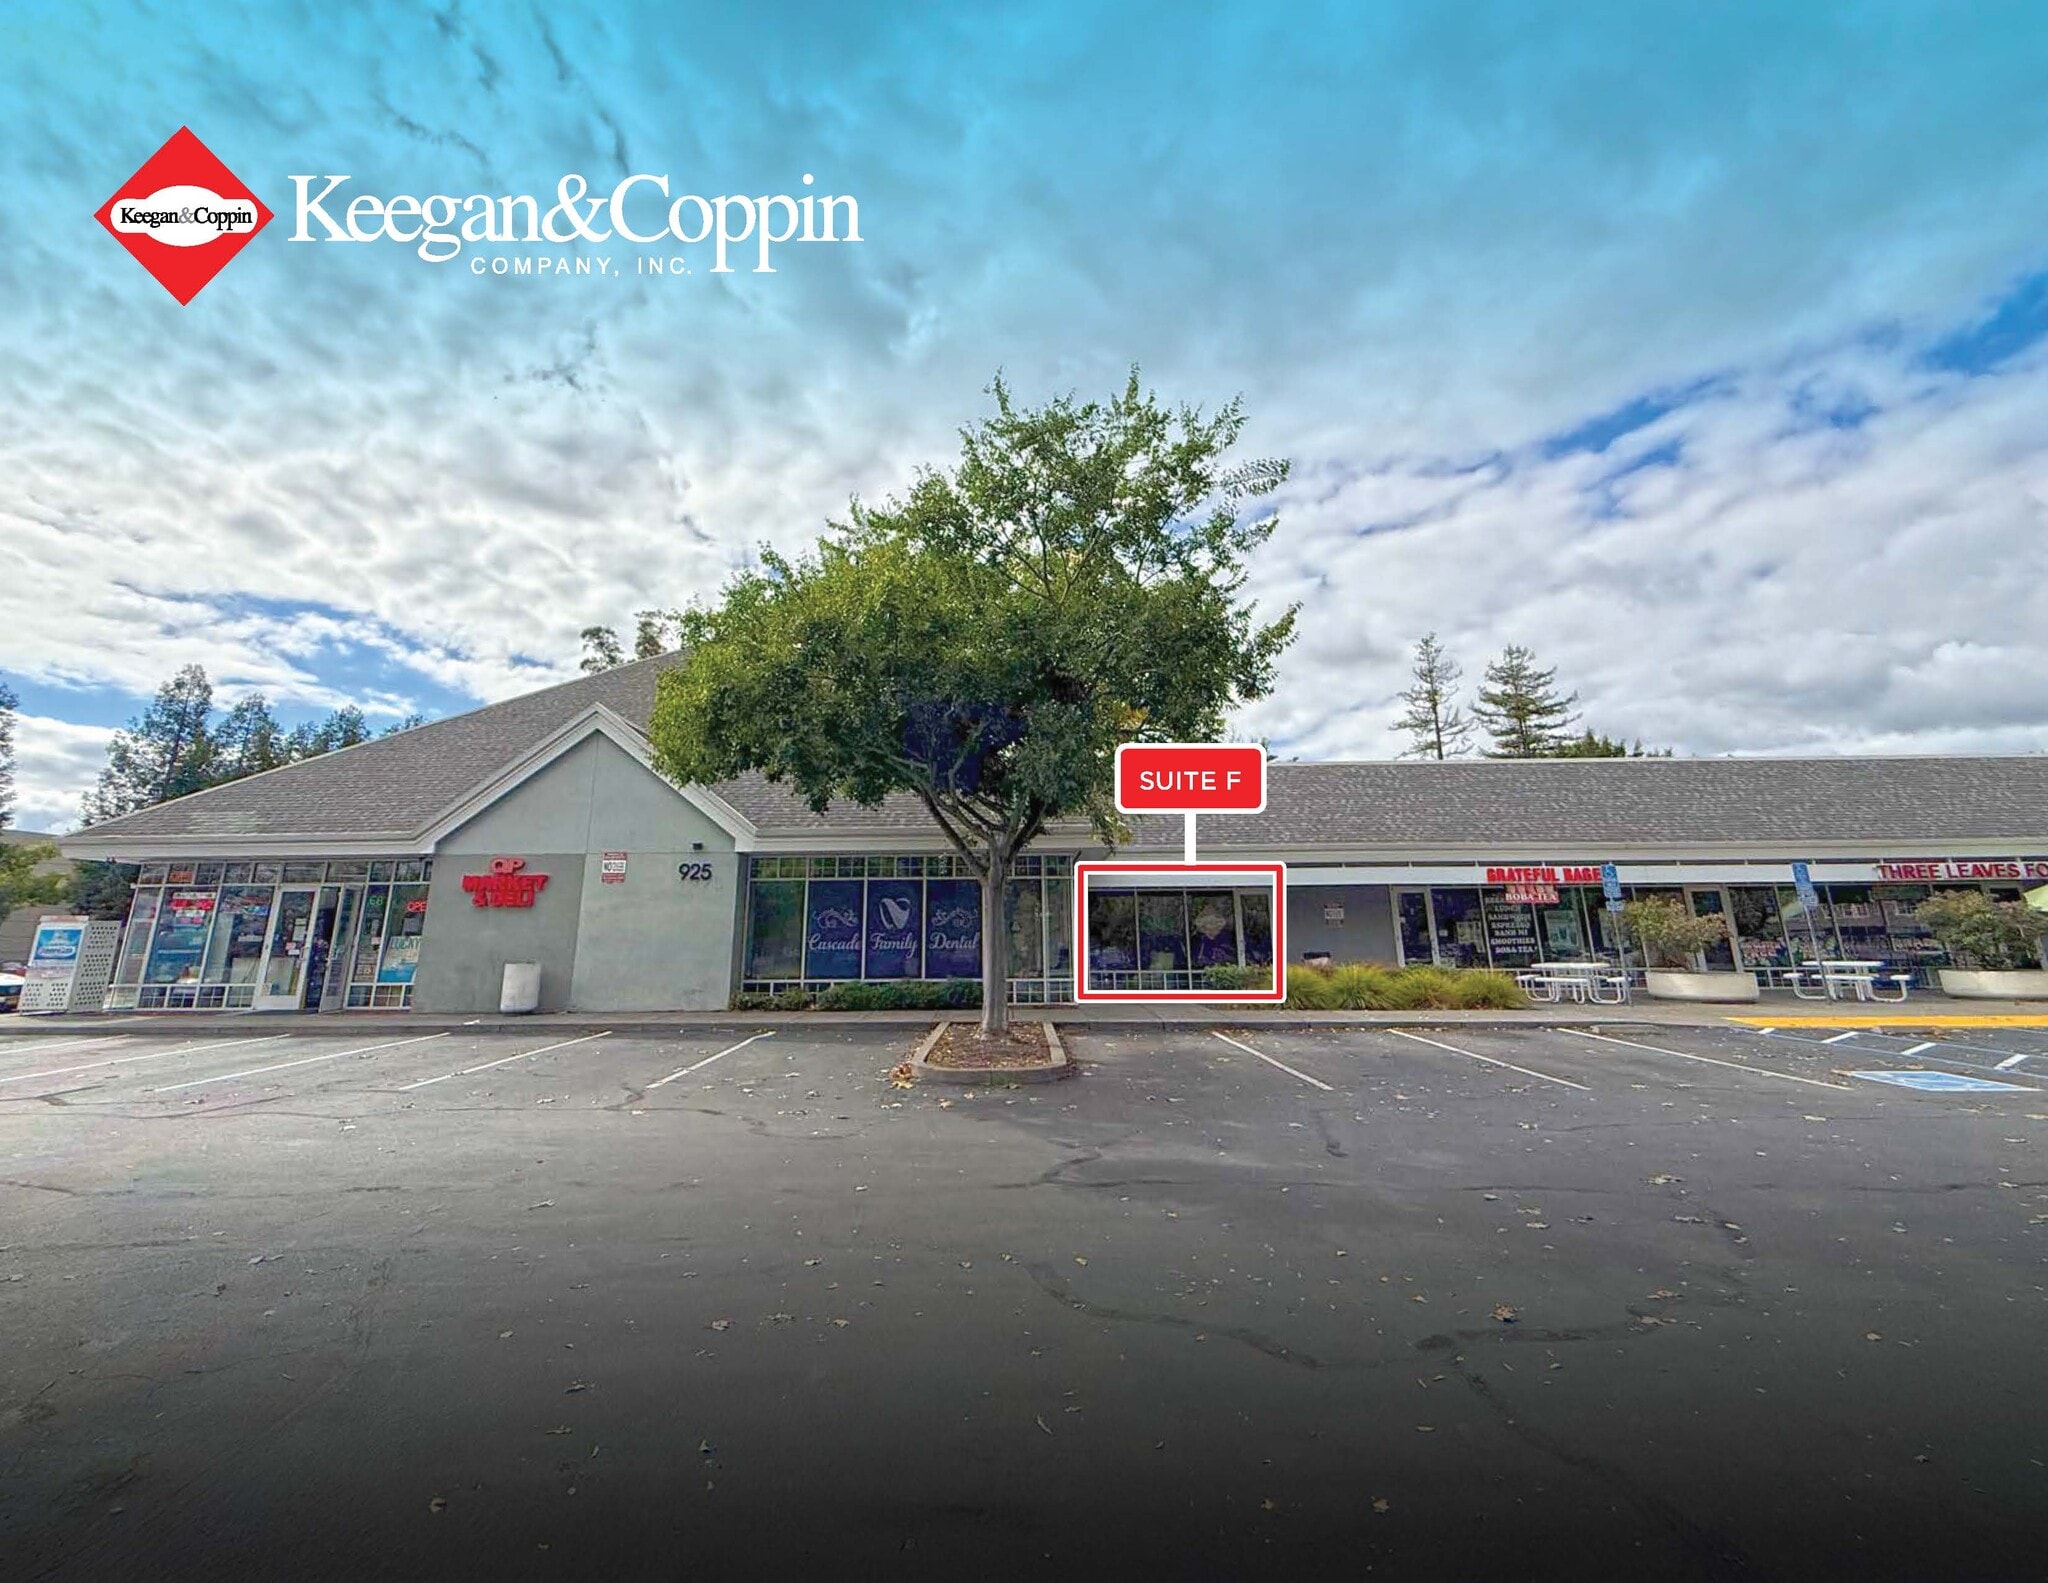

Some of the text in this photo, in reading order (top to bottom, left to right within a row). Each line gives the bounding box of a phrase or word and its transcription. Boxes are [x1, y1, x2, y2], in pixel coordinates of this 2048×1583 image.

[679, 863, 711, 881] 925
[1486, 867, 1559, 882] GRATEFUL
[1877, 864, 1940, 880] THREE
[1945, 863, 2021, 879] LEAVES
[1505, 893, 1534, 901] BOBA
[1538, 893, 1557, 901] TEA
[808, 931, 981, 960] Cascade Family Dental
